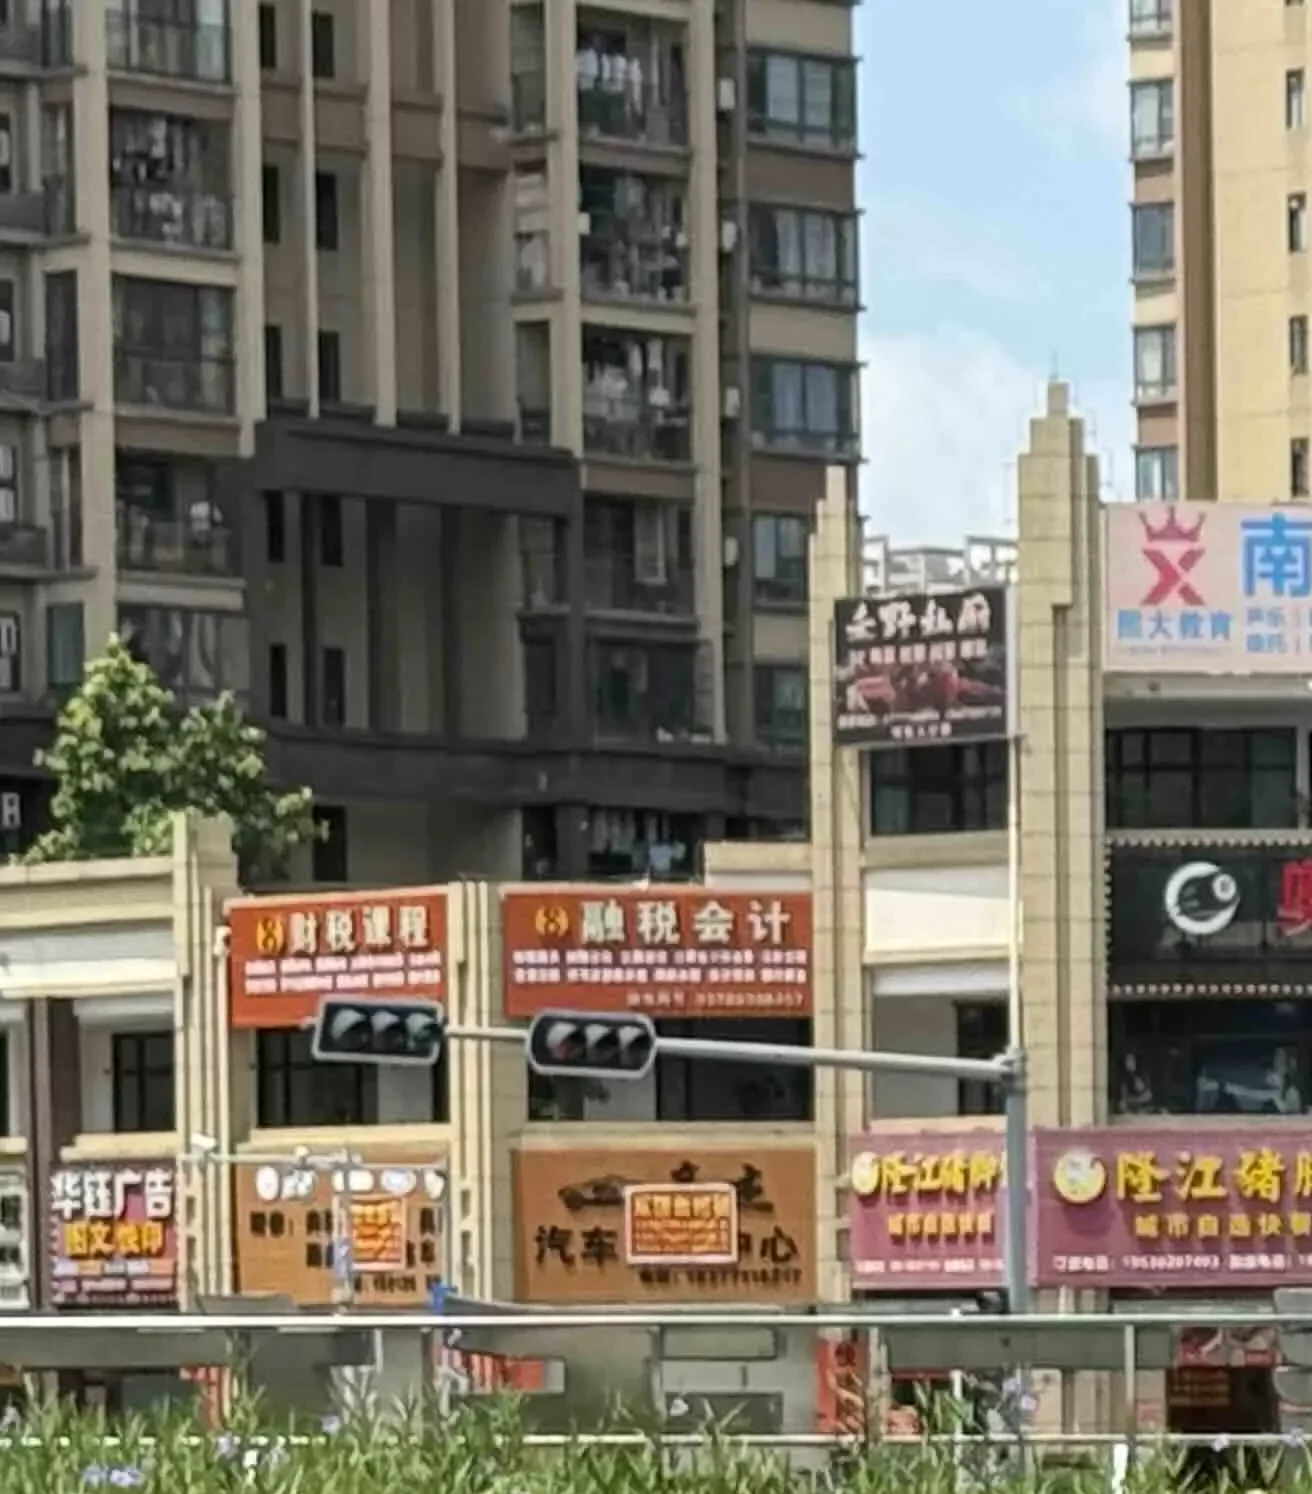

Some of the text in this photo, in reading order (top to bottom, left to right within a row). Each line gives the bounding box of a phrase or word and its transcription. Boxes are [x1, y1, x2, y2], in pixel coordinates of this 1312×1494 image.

[580, 899, 791, 944] 融税会计
[882, 1150, 1007, 1194] 隆江猪脚
